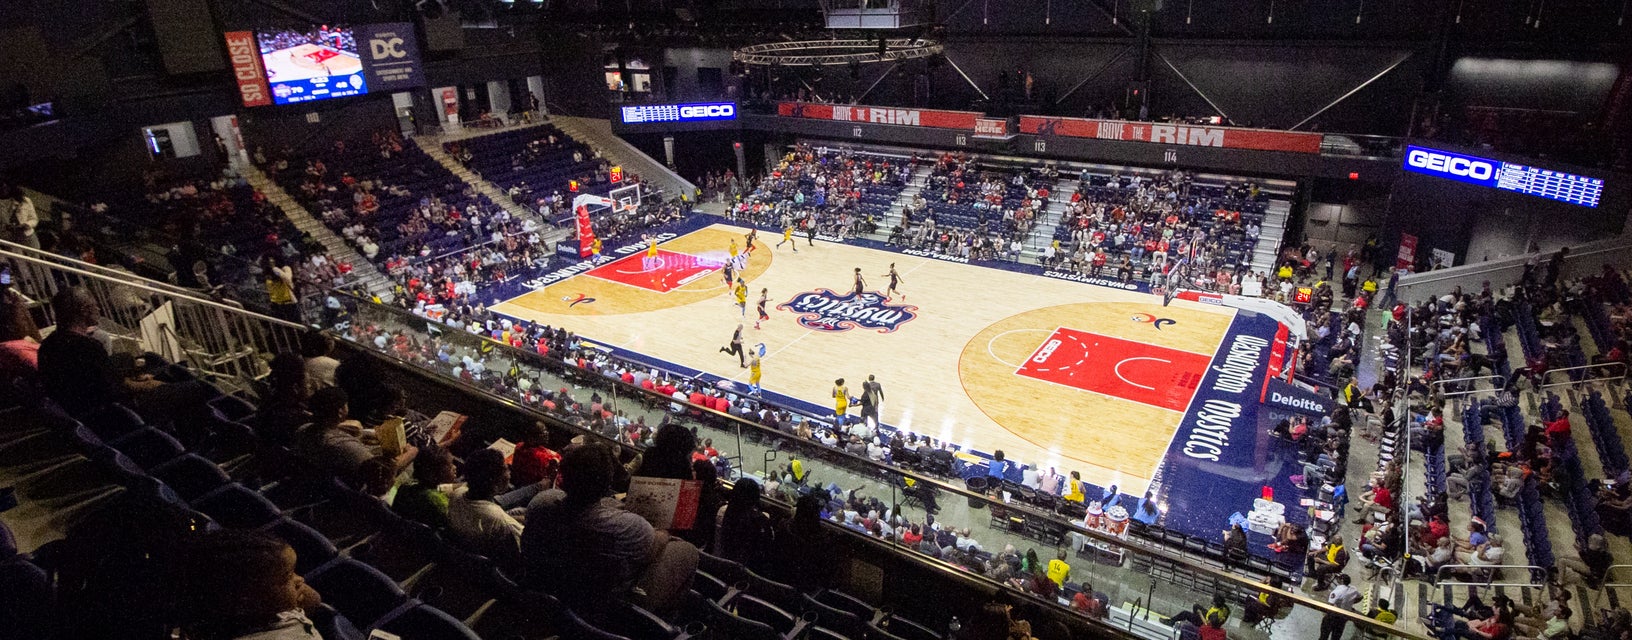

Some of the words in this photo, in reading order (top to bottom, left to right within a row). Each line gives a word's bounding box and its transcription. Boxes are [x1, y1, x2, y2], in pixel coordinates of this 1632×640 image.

[369, 37, 406, 60] DC
[227, 37, 257, 80] CLOSE
[240, 84, 262, 102] SO
[680, 105, 733, 117] GEICO
[833, 106, 851, 121] ABOVE
[870, 108, 920, 126] RIM
[853, 128, 862, 137] 112
[956, 136, 966, 146] 113
[1097, 122, 1124, 140] ABOVE
[1132, 126, 1144, 140] THE
[1150, 124, 1225, 147] RIM
[1034, 141, 1046, 152] 113
[1164, 151, 1177, 163] 114
[1408, 149, 1493, 181] GEICO
[1297, 292, 1309, 301] 24
[1033, 339, 1062, 363] GEICO
